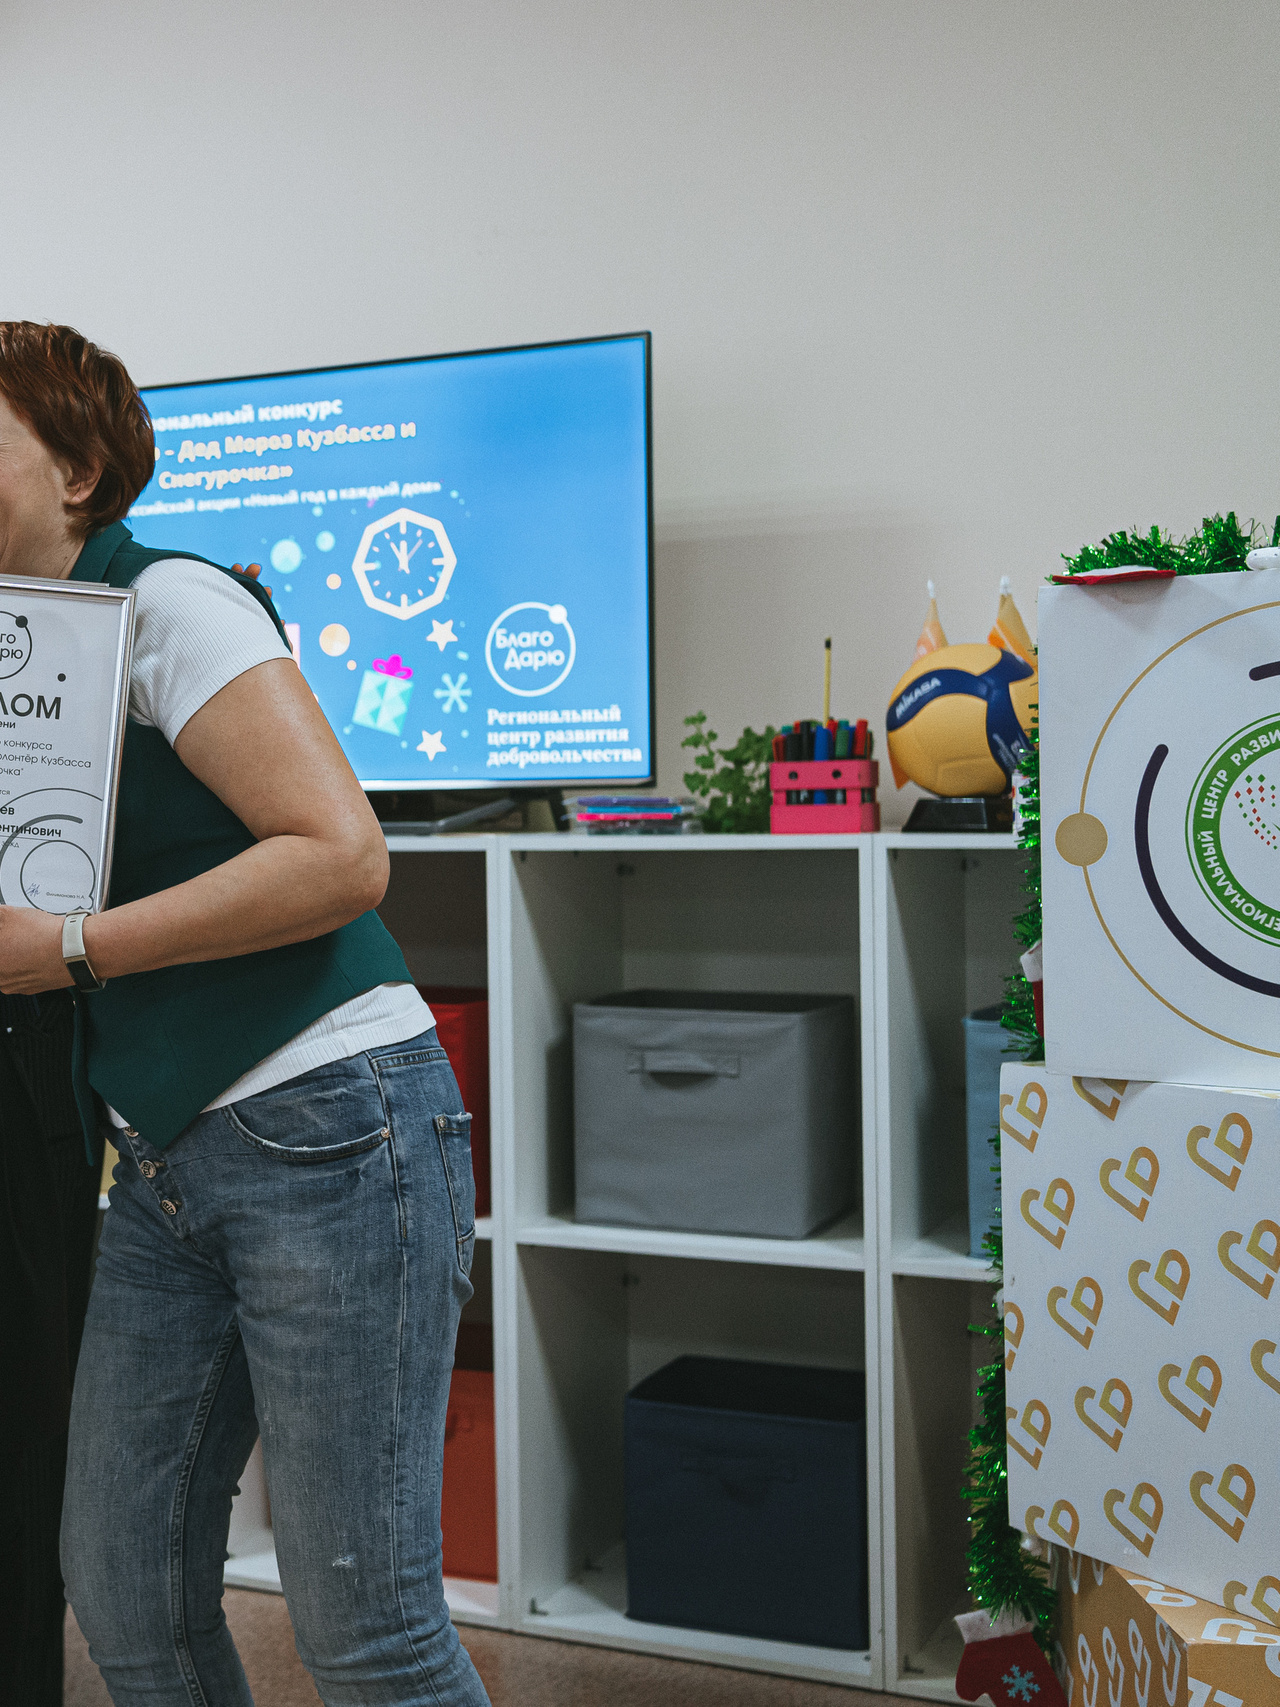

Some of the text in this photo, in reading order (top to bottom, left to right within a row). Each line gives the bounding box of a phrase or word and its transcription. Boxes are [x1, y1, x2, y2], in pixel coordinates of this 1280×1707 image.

[153, 399, 343, 431] ональный конкурс
[178, 440, 221, 463] Дед
[225, 434, 293, 457] Мороз
[297, 424, 396, 451] Кузбасса
[401, 422, 416, 438] и
[159, 465, 293, 490] Снегурочка»
[128, 498, 195, 517] ссийской
[301, 490, 327, 505] год
[495, 628, 554, 649] Благо
[504, 648, 565, 671] Дарю
[487, 704, 621, 726] Региональный
[4, 739, 53, 751] конкурса
[487, 728, 629, 749] центр развития
[41, 756, 92, 769] Кузбасса
[486, 747, 643, 769] добровольчества
[1197, 728, 1280, 933] ЕГИОНАЛЬНЫЙ ЦЕНТР РАЗВИ
